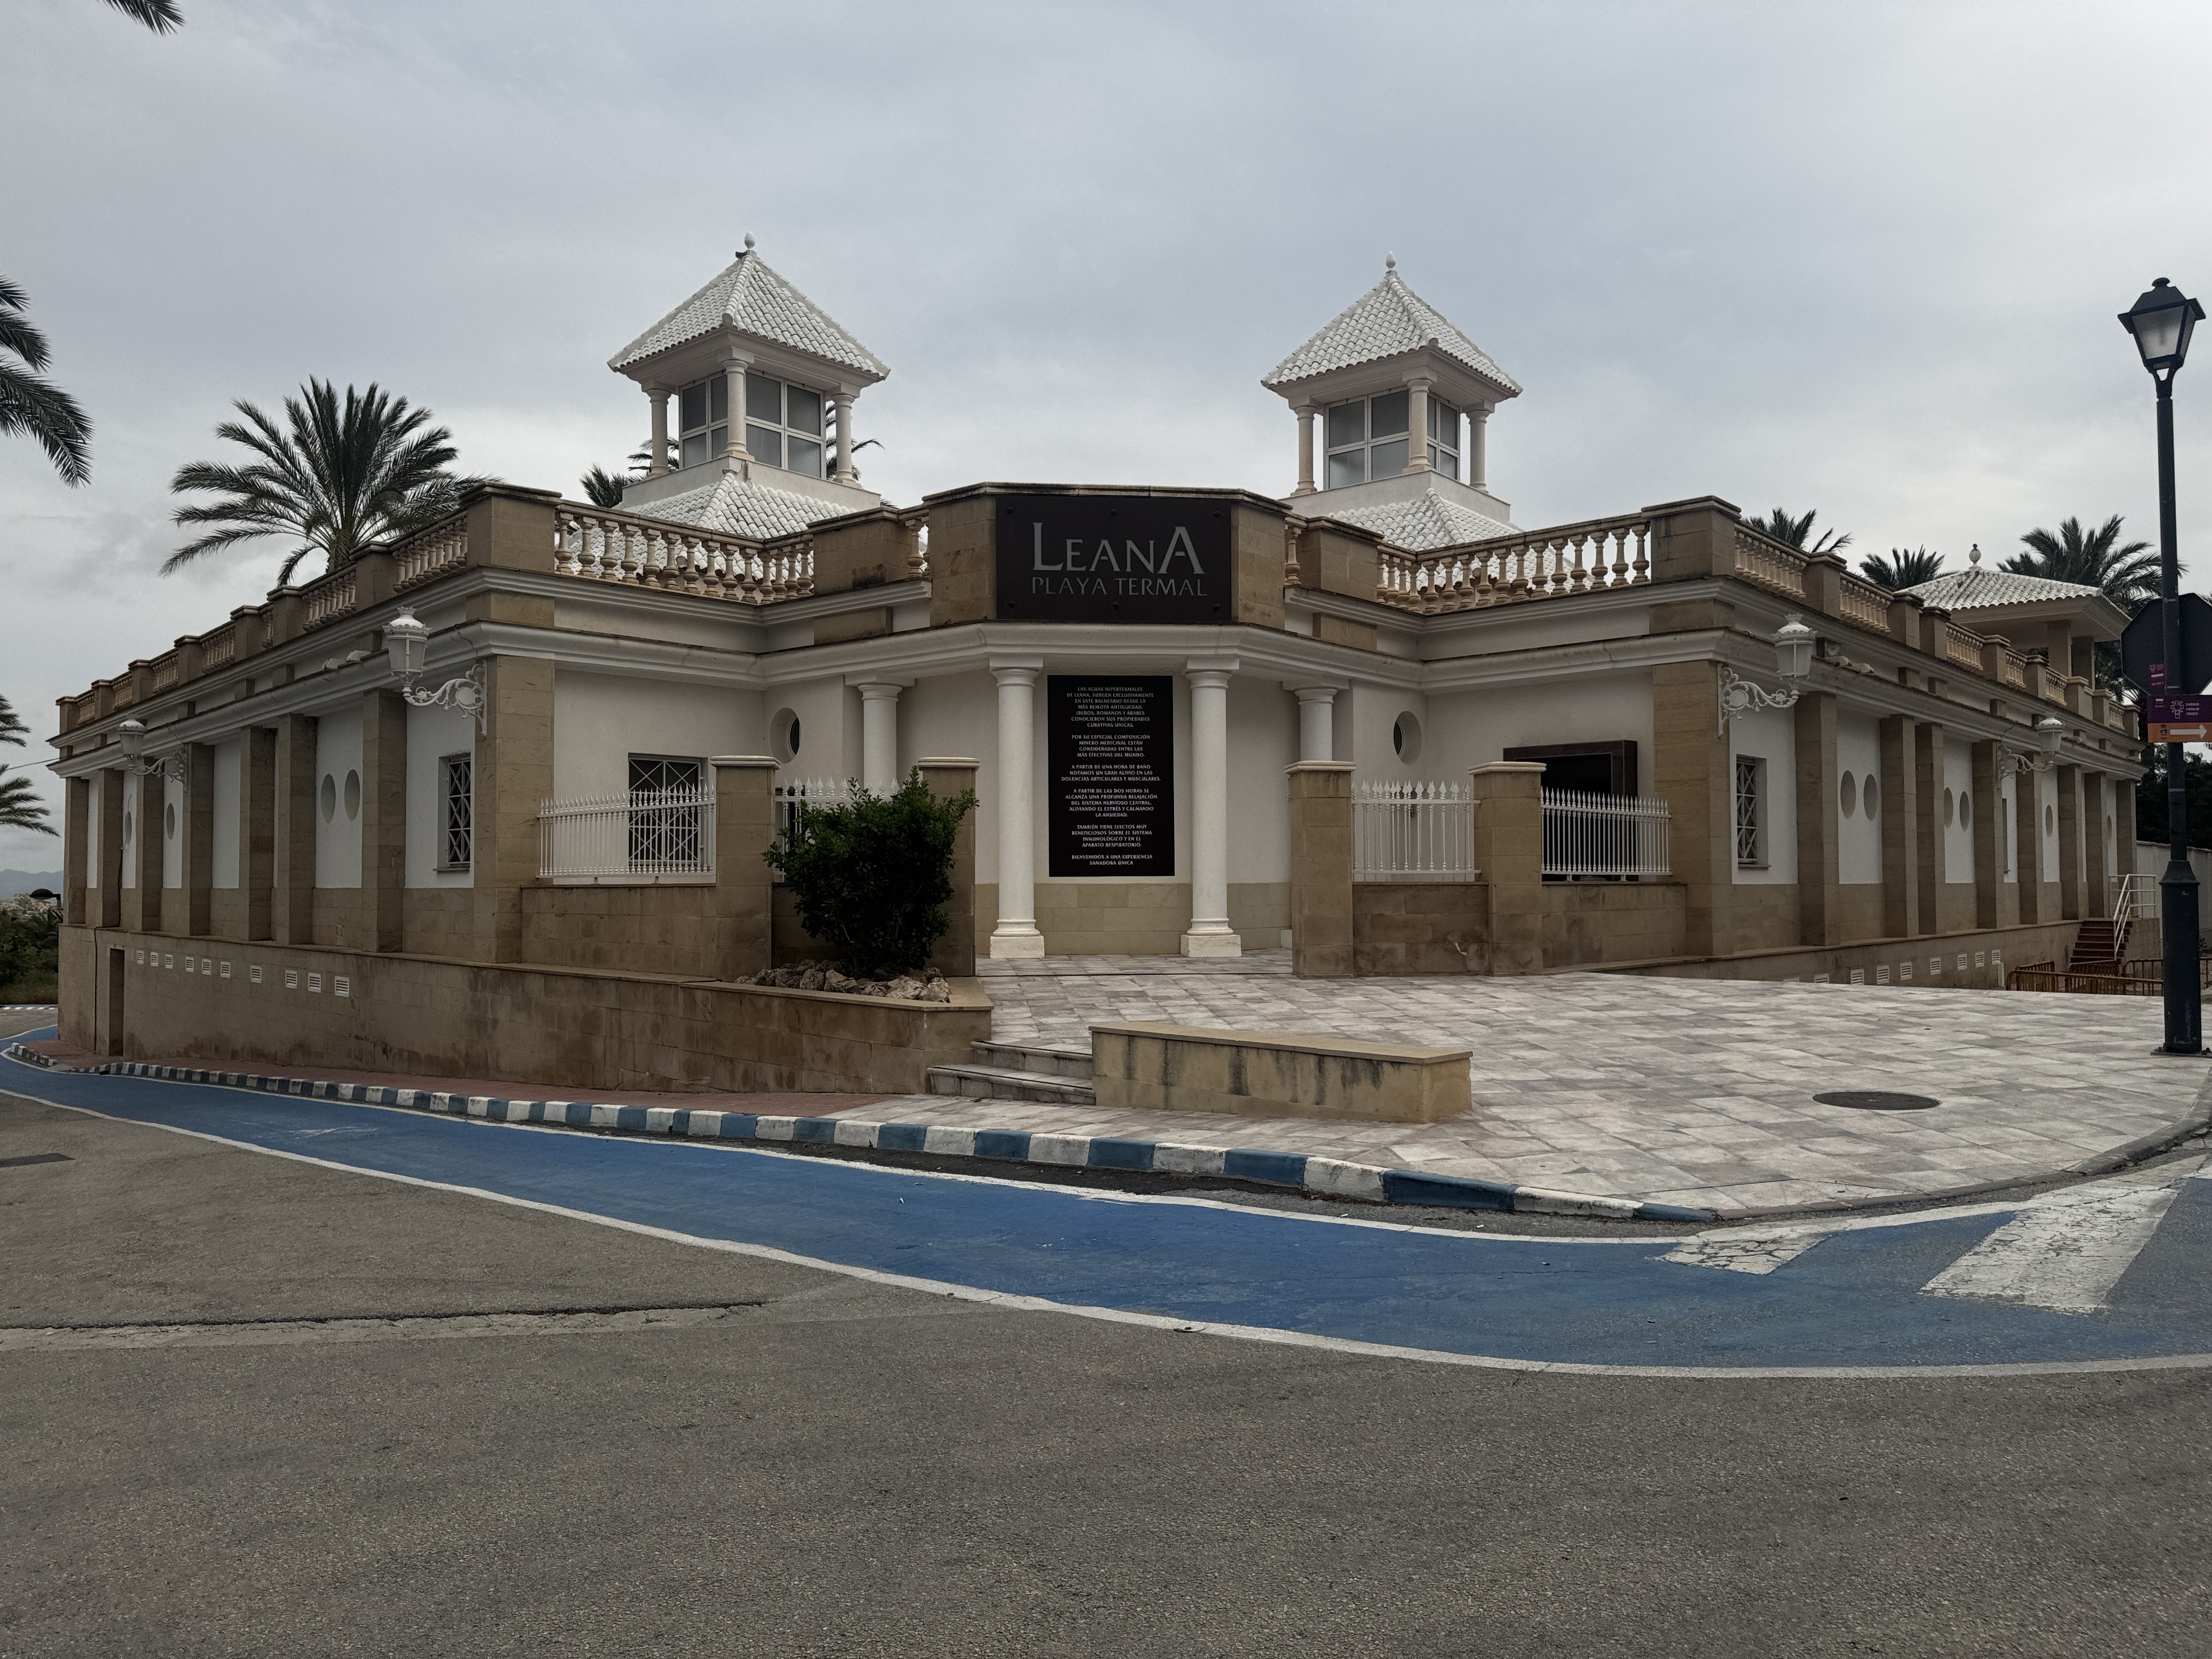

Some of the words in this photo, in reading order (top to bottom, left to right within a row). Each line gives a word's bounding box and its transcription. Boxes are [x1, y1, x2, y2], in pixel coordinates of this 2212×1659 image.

[1031, 522, 1205, 574] LEANA
[1032, 577, 1107, 595] PLAYA
[1114, 578, 1207, 596] TERMAL
